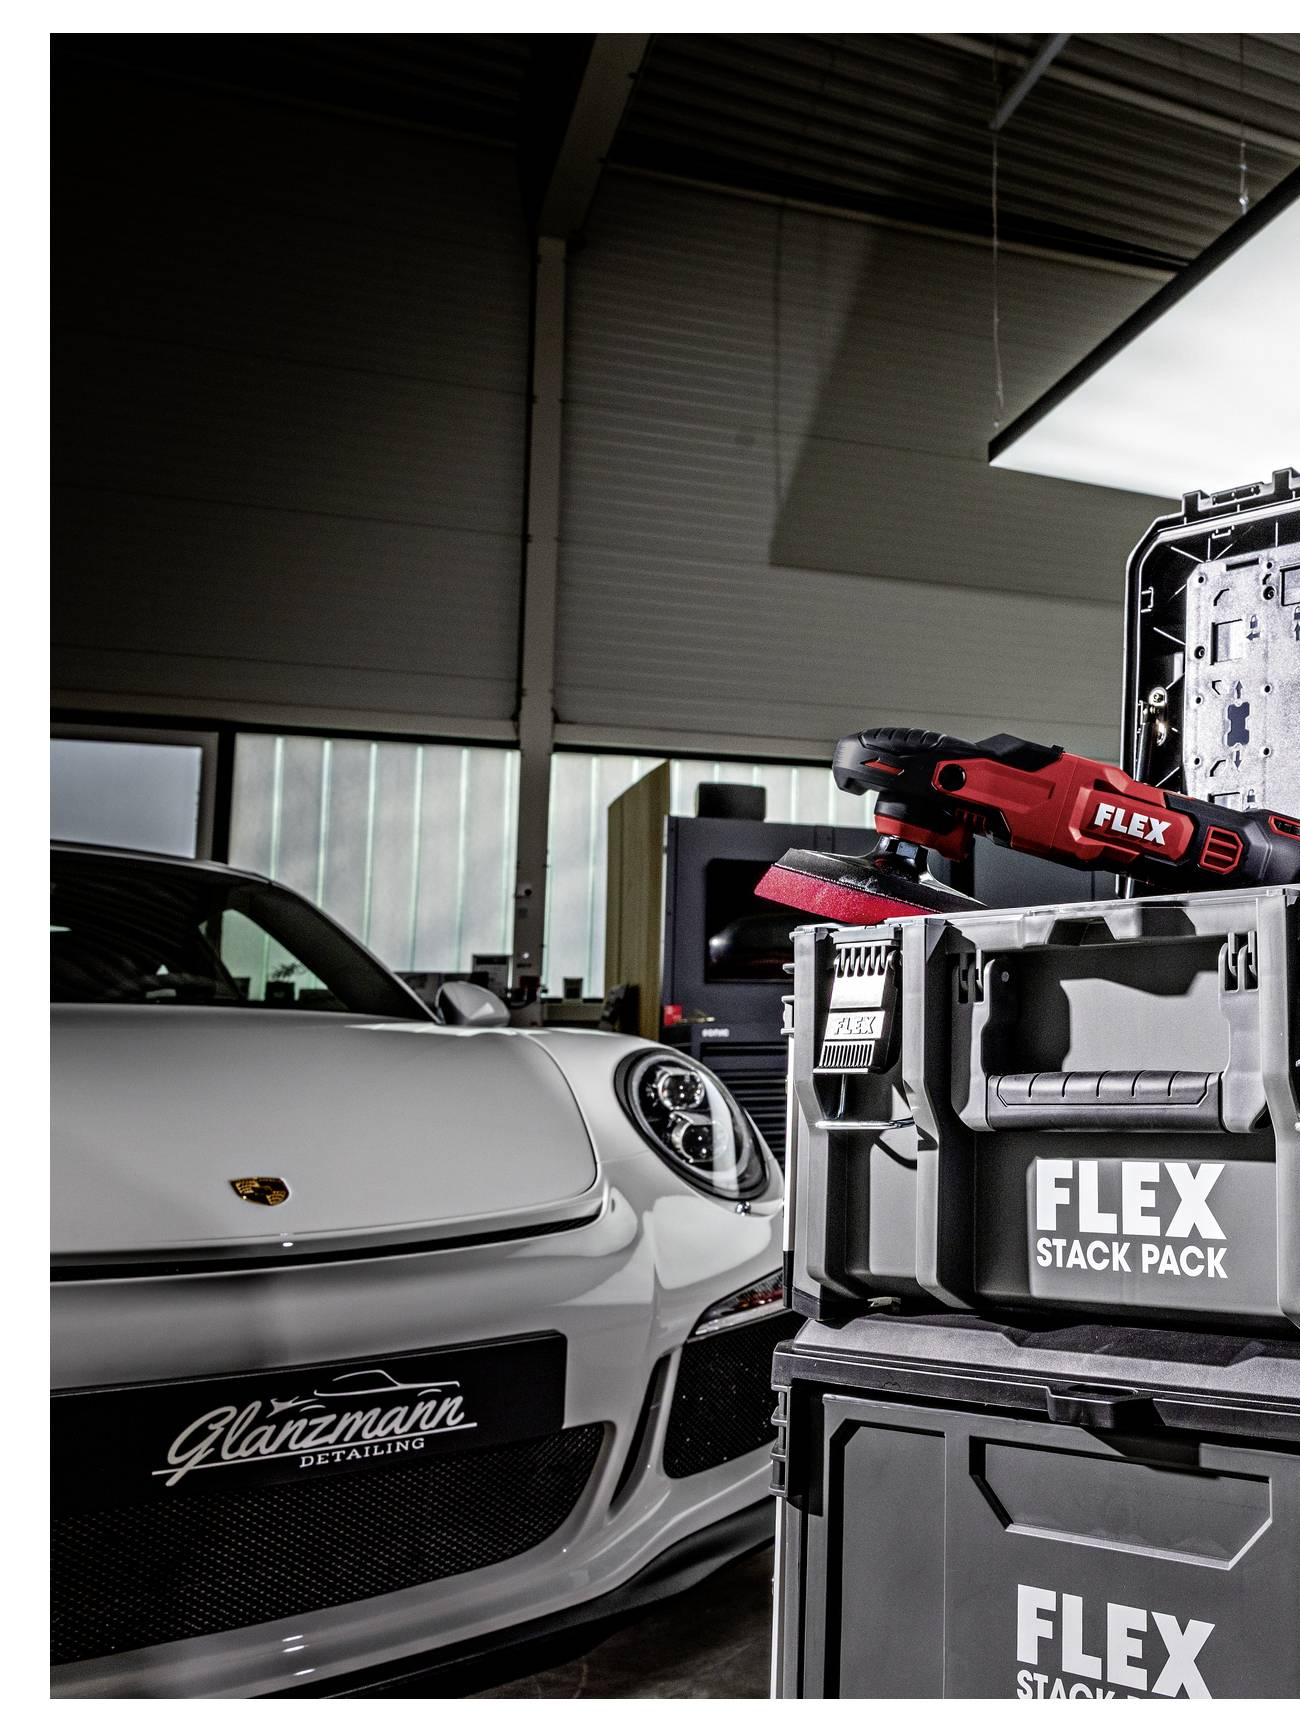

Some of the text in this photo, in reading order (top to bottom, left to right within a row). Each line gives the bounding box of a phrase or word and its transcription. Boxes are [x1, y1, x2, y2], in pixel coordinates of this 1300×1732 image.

[1094, 802, 1172, 846] FLEX
[834, 1016, 877, 1036] FLEX
[1036, 1159, 1227, 1240] FLEX
[1036, 1237, 1229, 1279] STACK PACK
[166, 1395, 466, 1487] Glanzmann
[299, 1437, 425, 1469] DETAILING
[1016, 1583, 1216, 1699] FLEX
